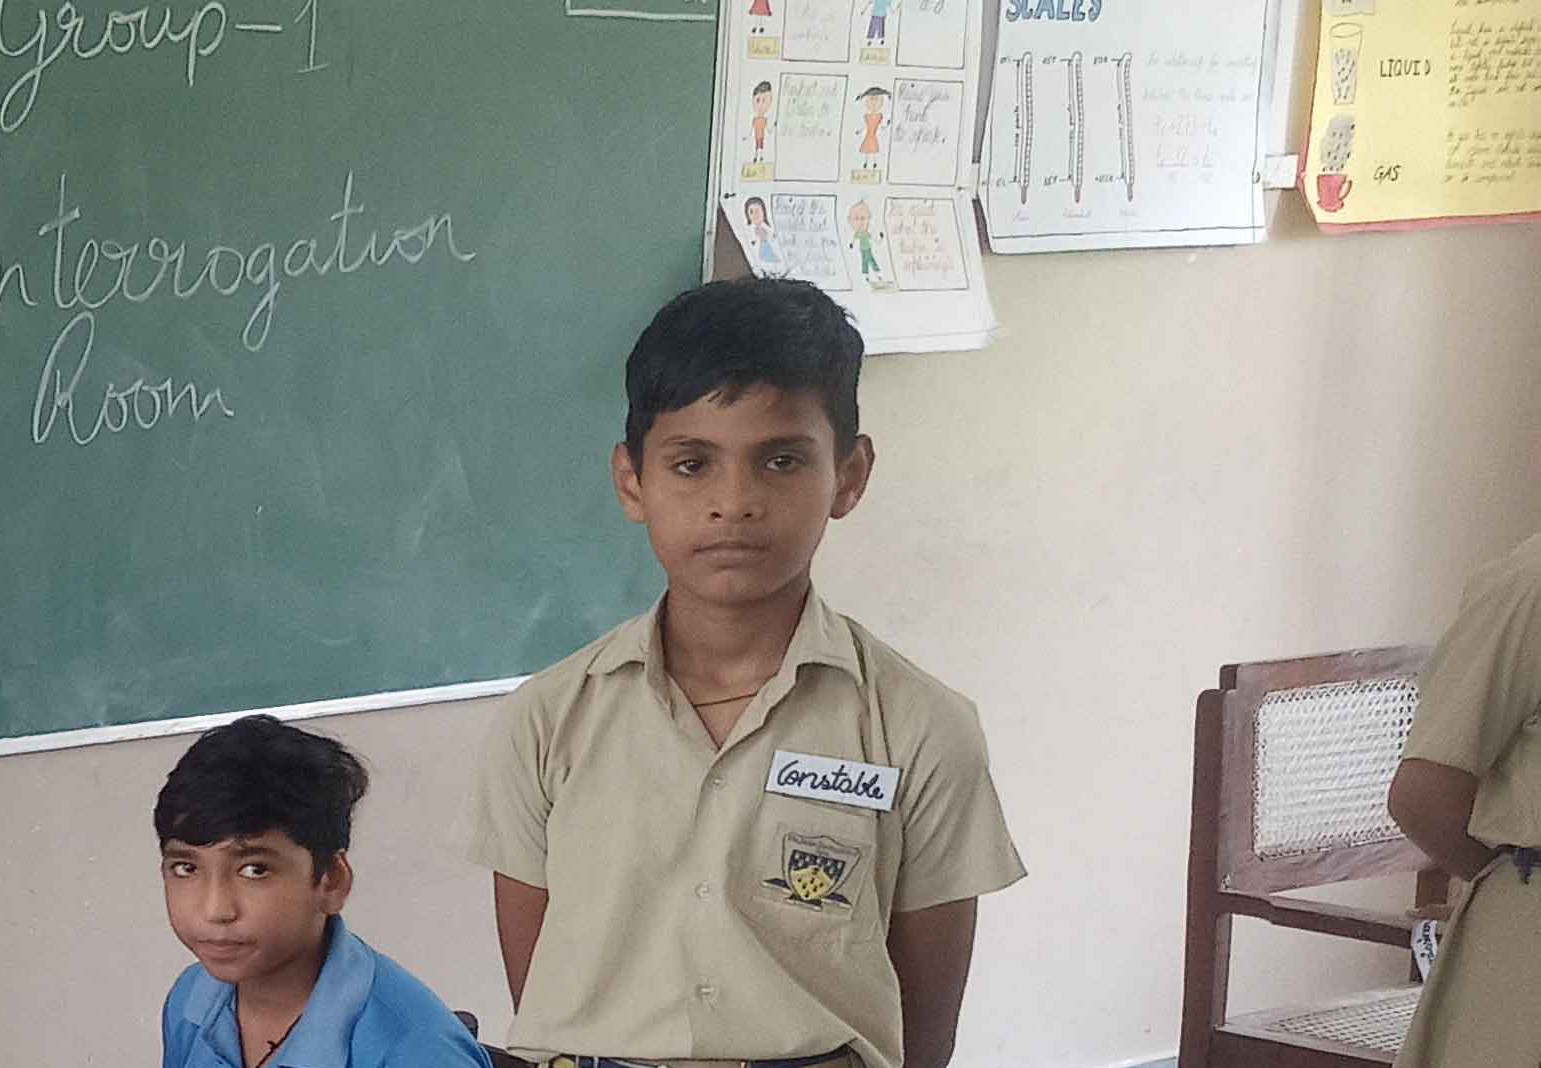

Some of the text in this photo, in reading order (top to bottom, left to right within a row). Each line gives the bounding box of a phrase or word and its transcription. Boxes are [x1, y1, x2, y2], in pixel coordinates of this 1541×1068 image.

[1380, 58, 1431, 78] LIQUID
[1373, 164, 1402, 182] GAS
[33, 311, 235, 446] Room
[777, 760, 884, 800] Constable
